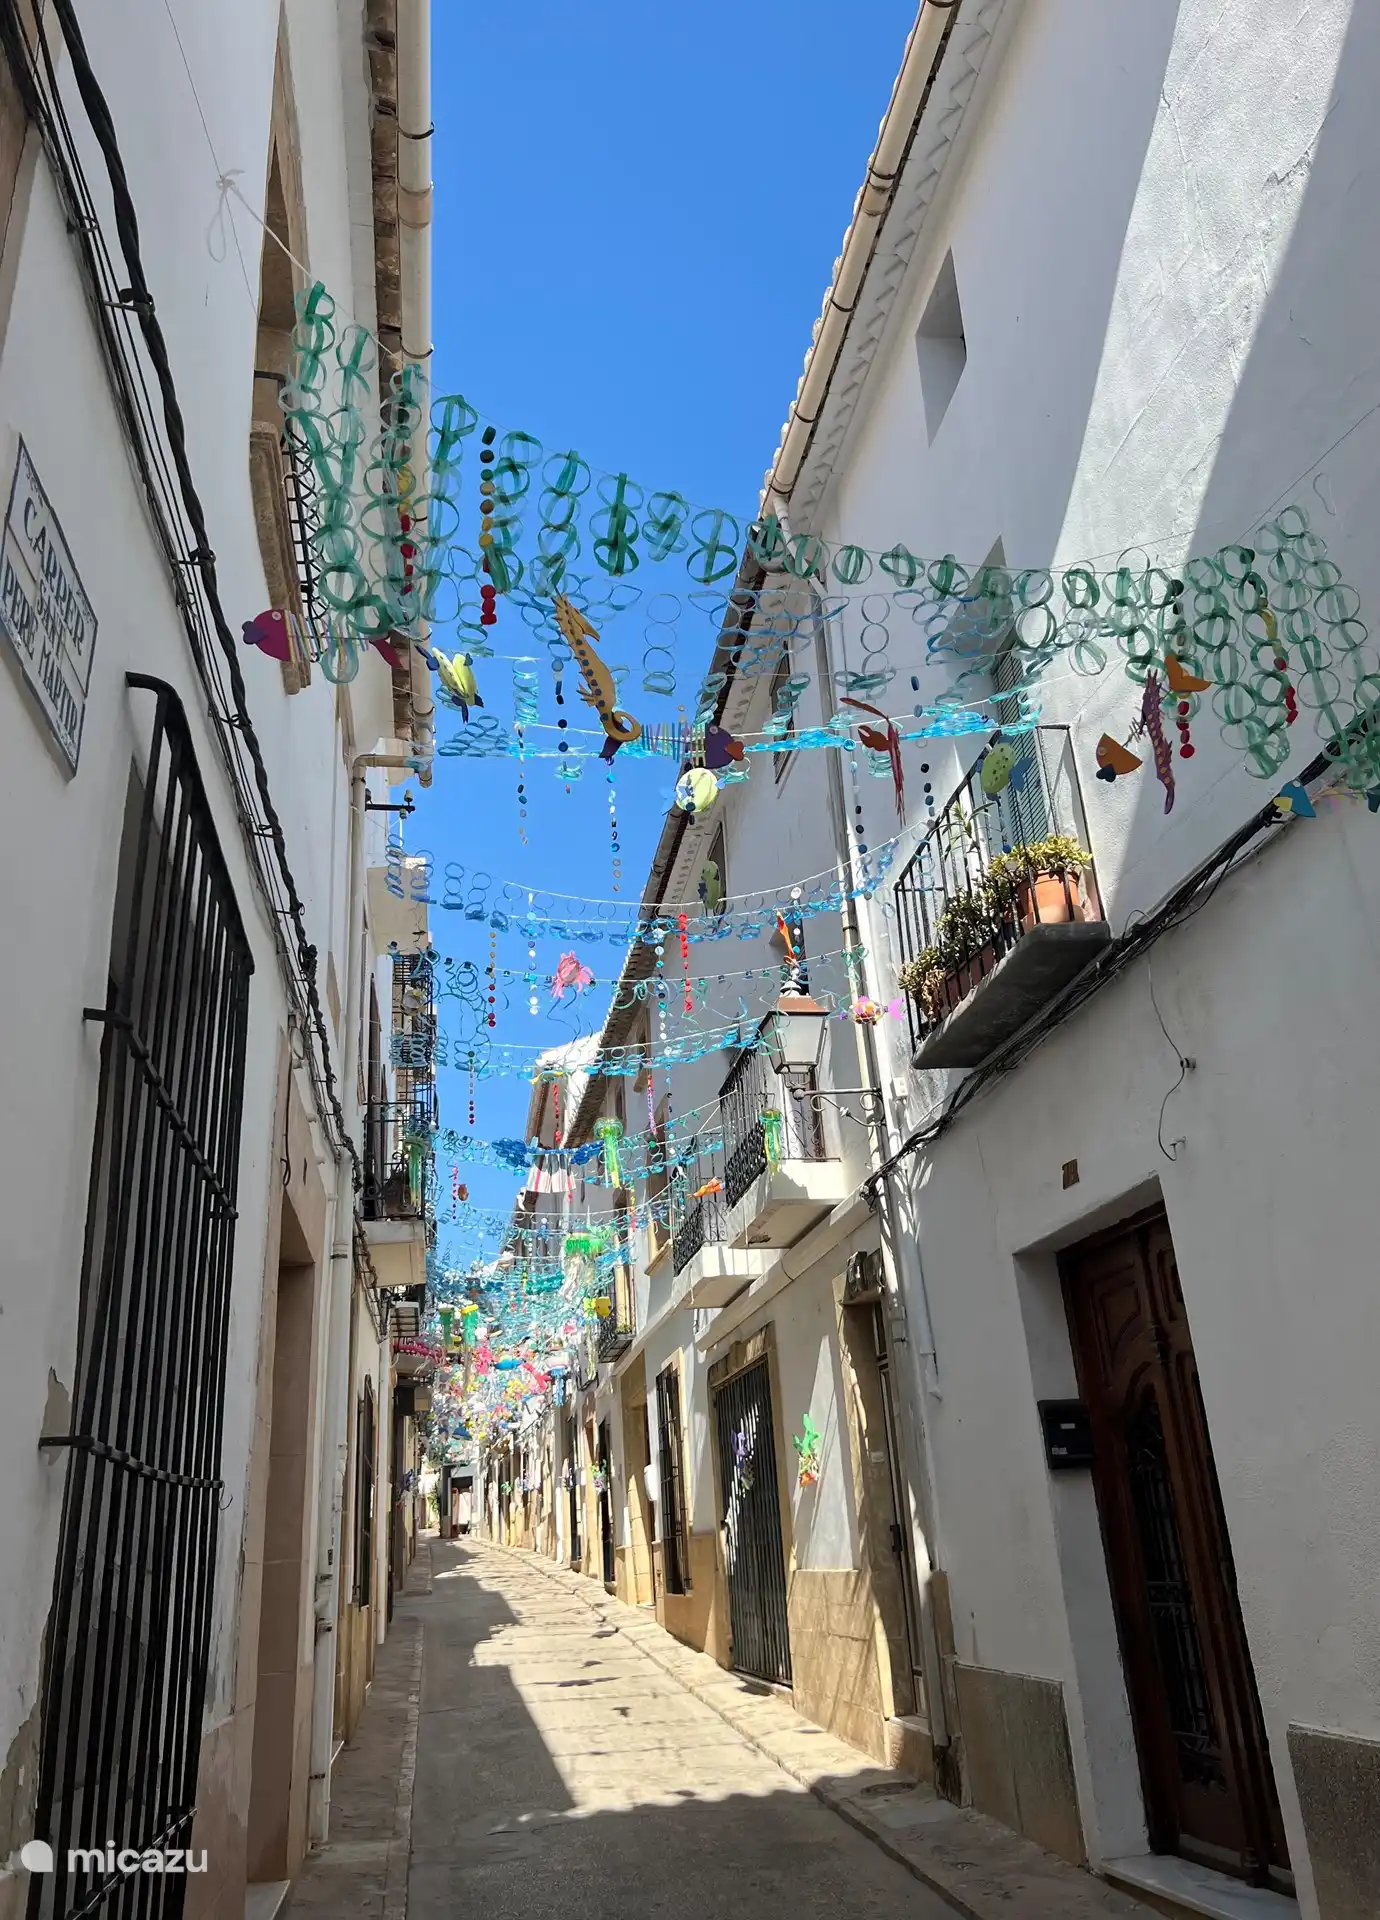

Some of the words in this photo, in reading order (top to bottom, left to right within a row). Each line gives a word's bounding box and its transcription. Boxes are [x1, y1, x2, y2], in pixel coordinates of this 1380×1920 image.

[2, 555, 39, 660] PERE
[24, 497, 84, 656] CARRER
[36, 578, 66, 660] SANT
